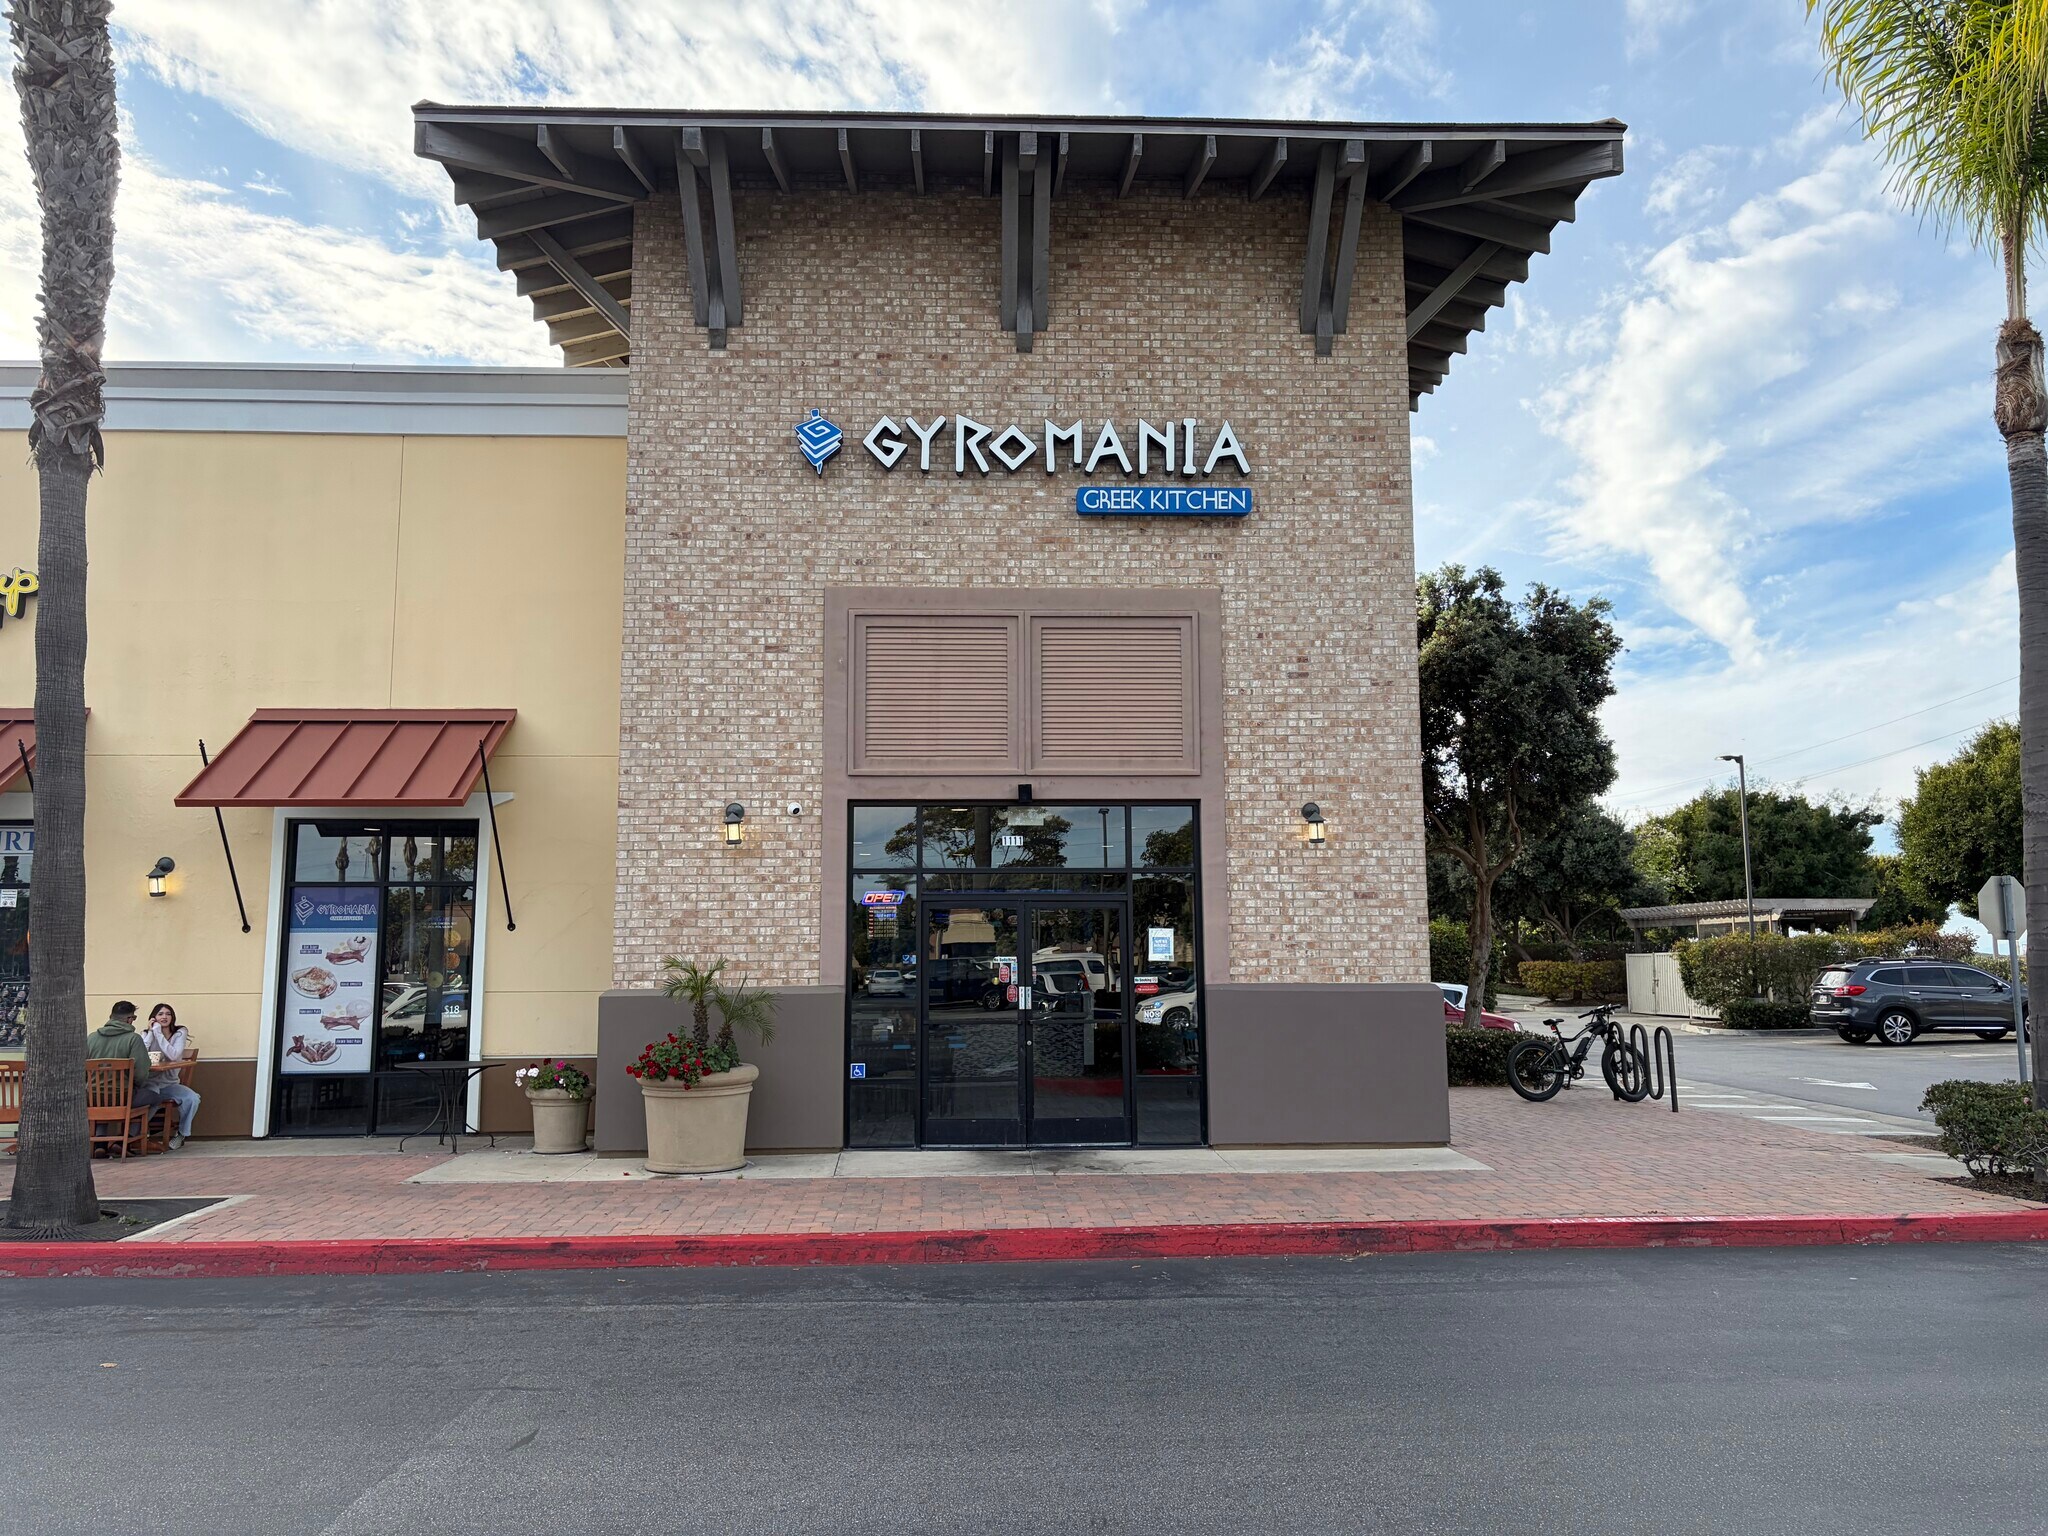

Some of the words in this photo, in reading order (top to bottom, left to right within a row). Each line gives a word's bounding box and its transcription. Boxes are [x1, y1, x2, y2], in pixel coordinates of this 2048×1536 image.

[862, 413, 1251, 477] GYROMANIA
[1083, 489, 1145, 510] GREEK
[1150, 490, 1246, 510] KITCHEN
[1003, 836, 1022, 846] 1111
[864, 893, 902, 903] OPEN
[316, 903, 377, 915] GYROMANIA
[444, 1004, 460, 1015] $18
